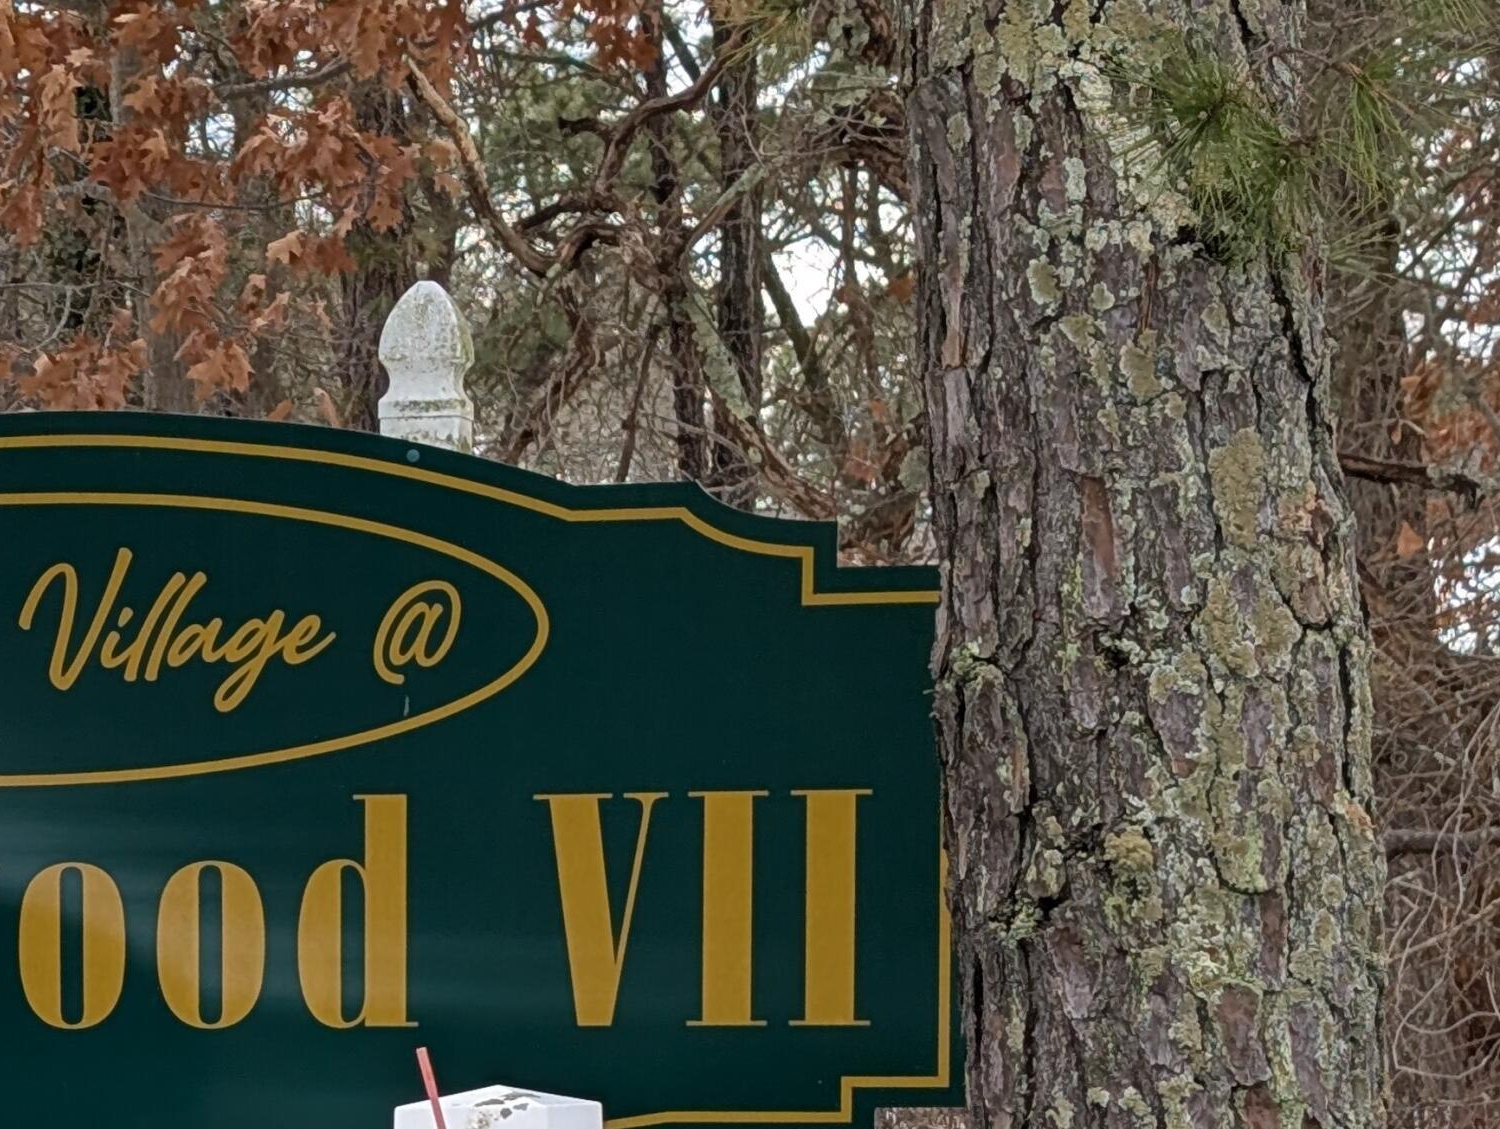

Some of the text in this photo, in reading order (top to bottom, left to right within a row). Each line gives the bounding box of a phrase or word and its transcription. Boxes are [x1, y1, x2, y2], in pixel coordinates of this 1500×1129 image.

[17, 547, 336, 713] Village
[372, 580, 462, 684] @
[533, 788, 874, 1028] VII
